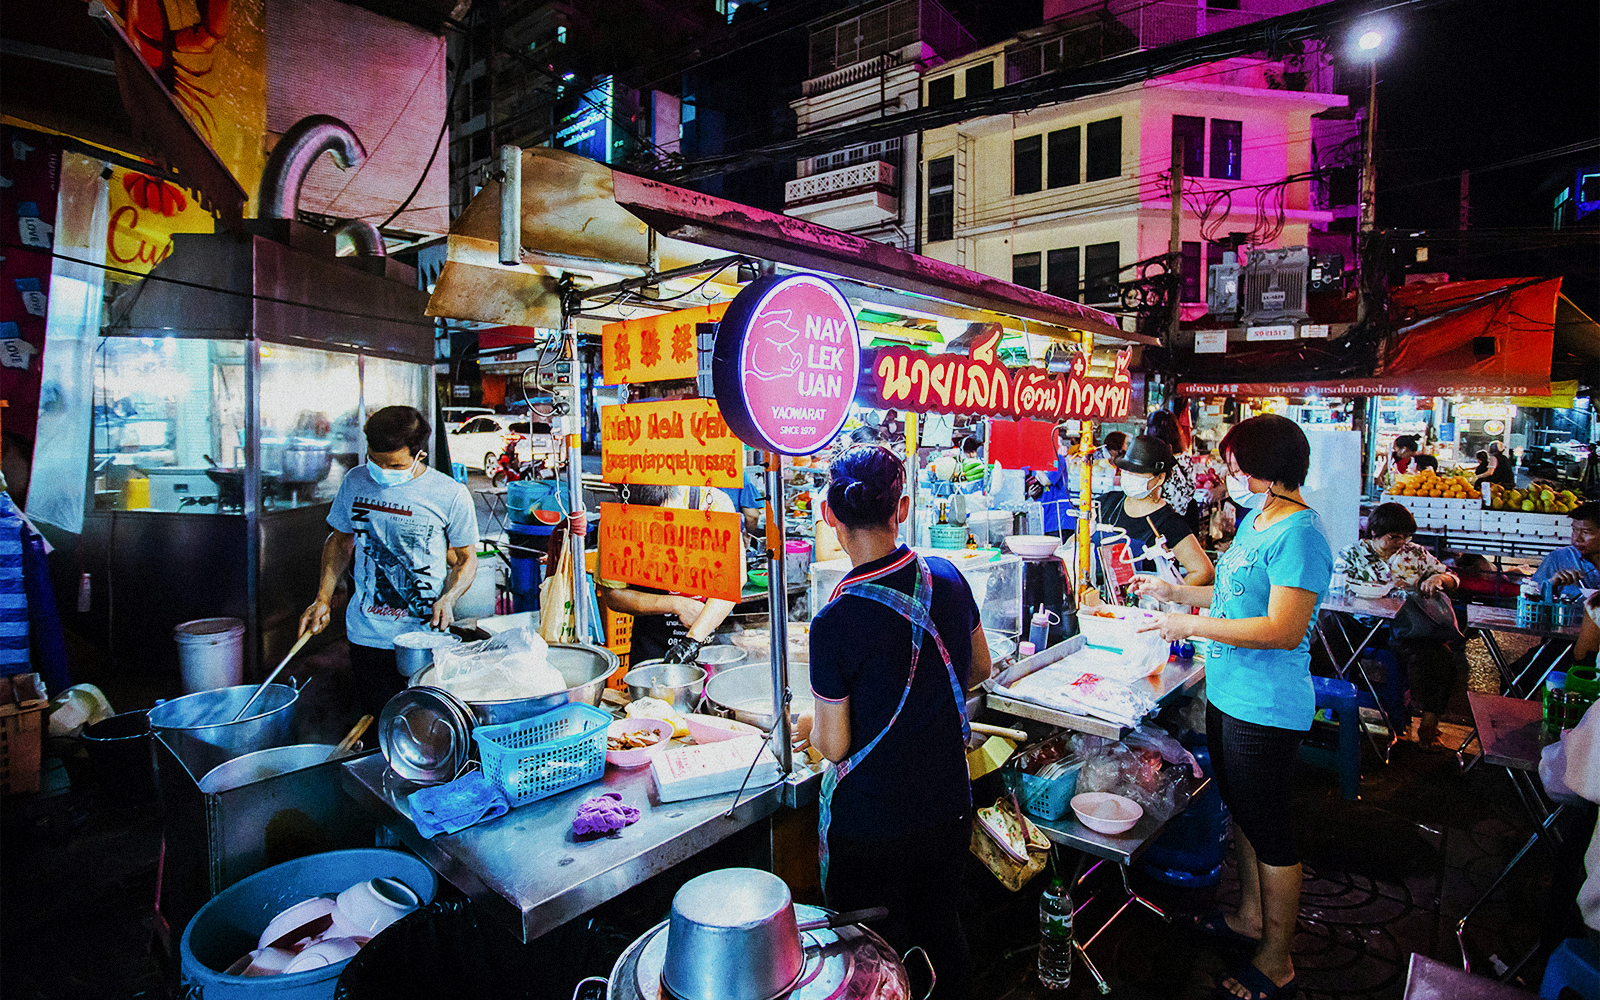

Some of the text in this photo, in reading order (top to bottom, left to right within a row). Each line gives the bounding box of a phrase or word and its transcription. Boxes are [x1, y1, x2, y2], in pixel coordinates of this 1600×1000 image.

[24, 217, 39, 244] LOVE
[29, 291, 43, 315] LOVE
[804, 315, 848, 343] NAY
[3, 340, 22, 365] LOVE
[806, 344, 845, 371] LEK
[798, 371, 843, 399] UAN
[878, 330, 1010, 409] นายเล็ก
[1013, 374, 1063, 418] (อ้วน)
[1437, 386, 1528, 394] 02-222-2219
[771, 406, 827, 421] YAOWARAT
[780, 425, 817, 435] SINCE 1979
[366, 604, 409, 622] vintage
